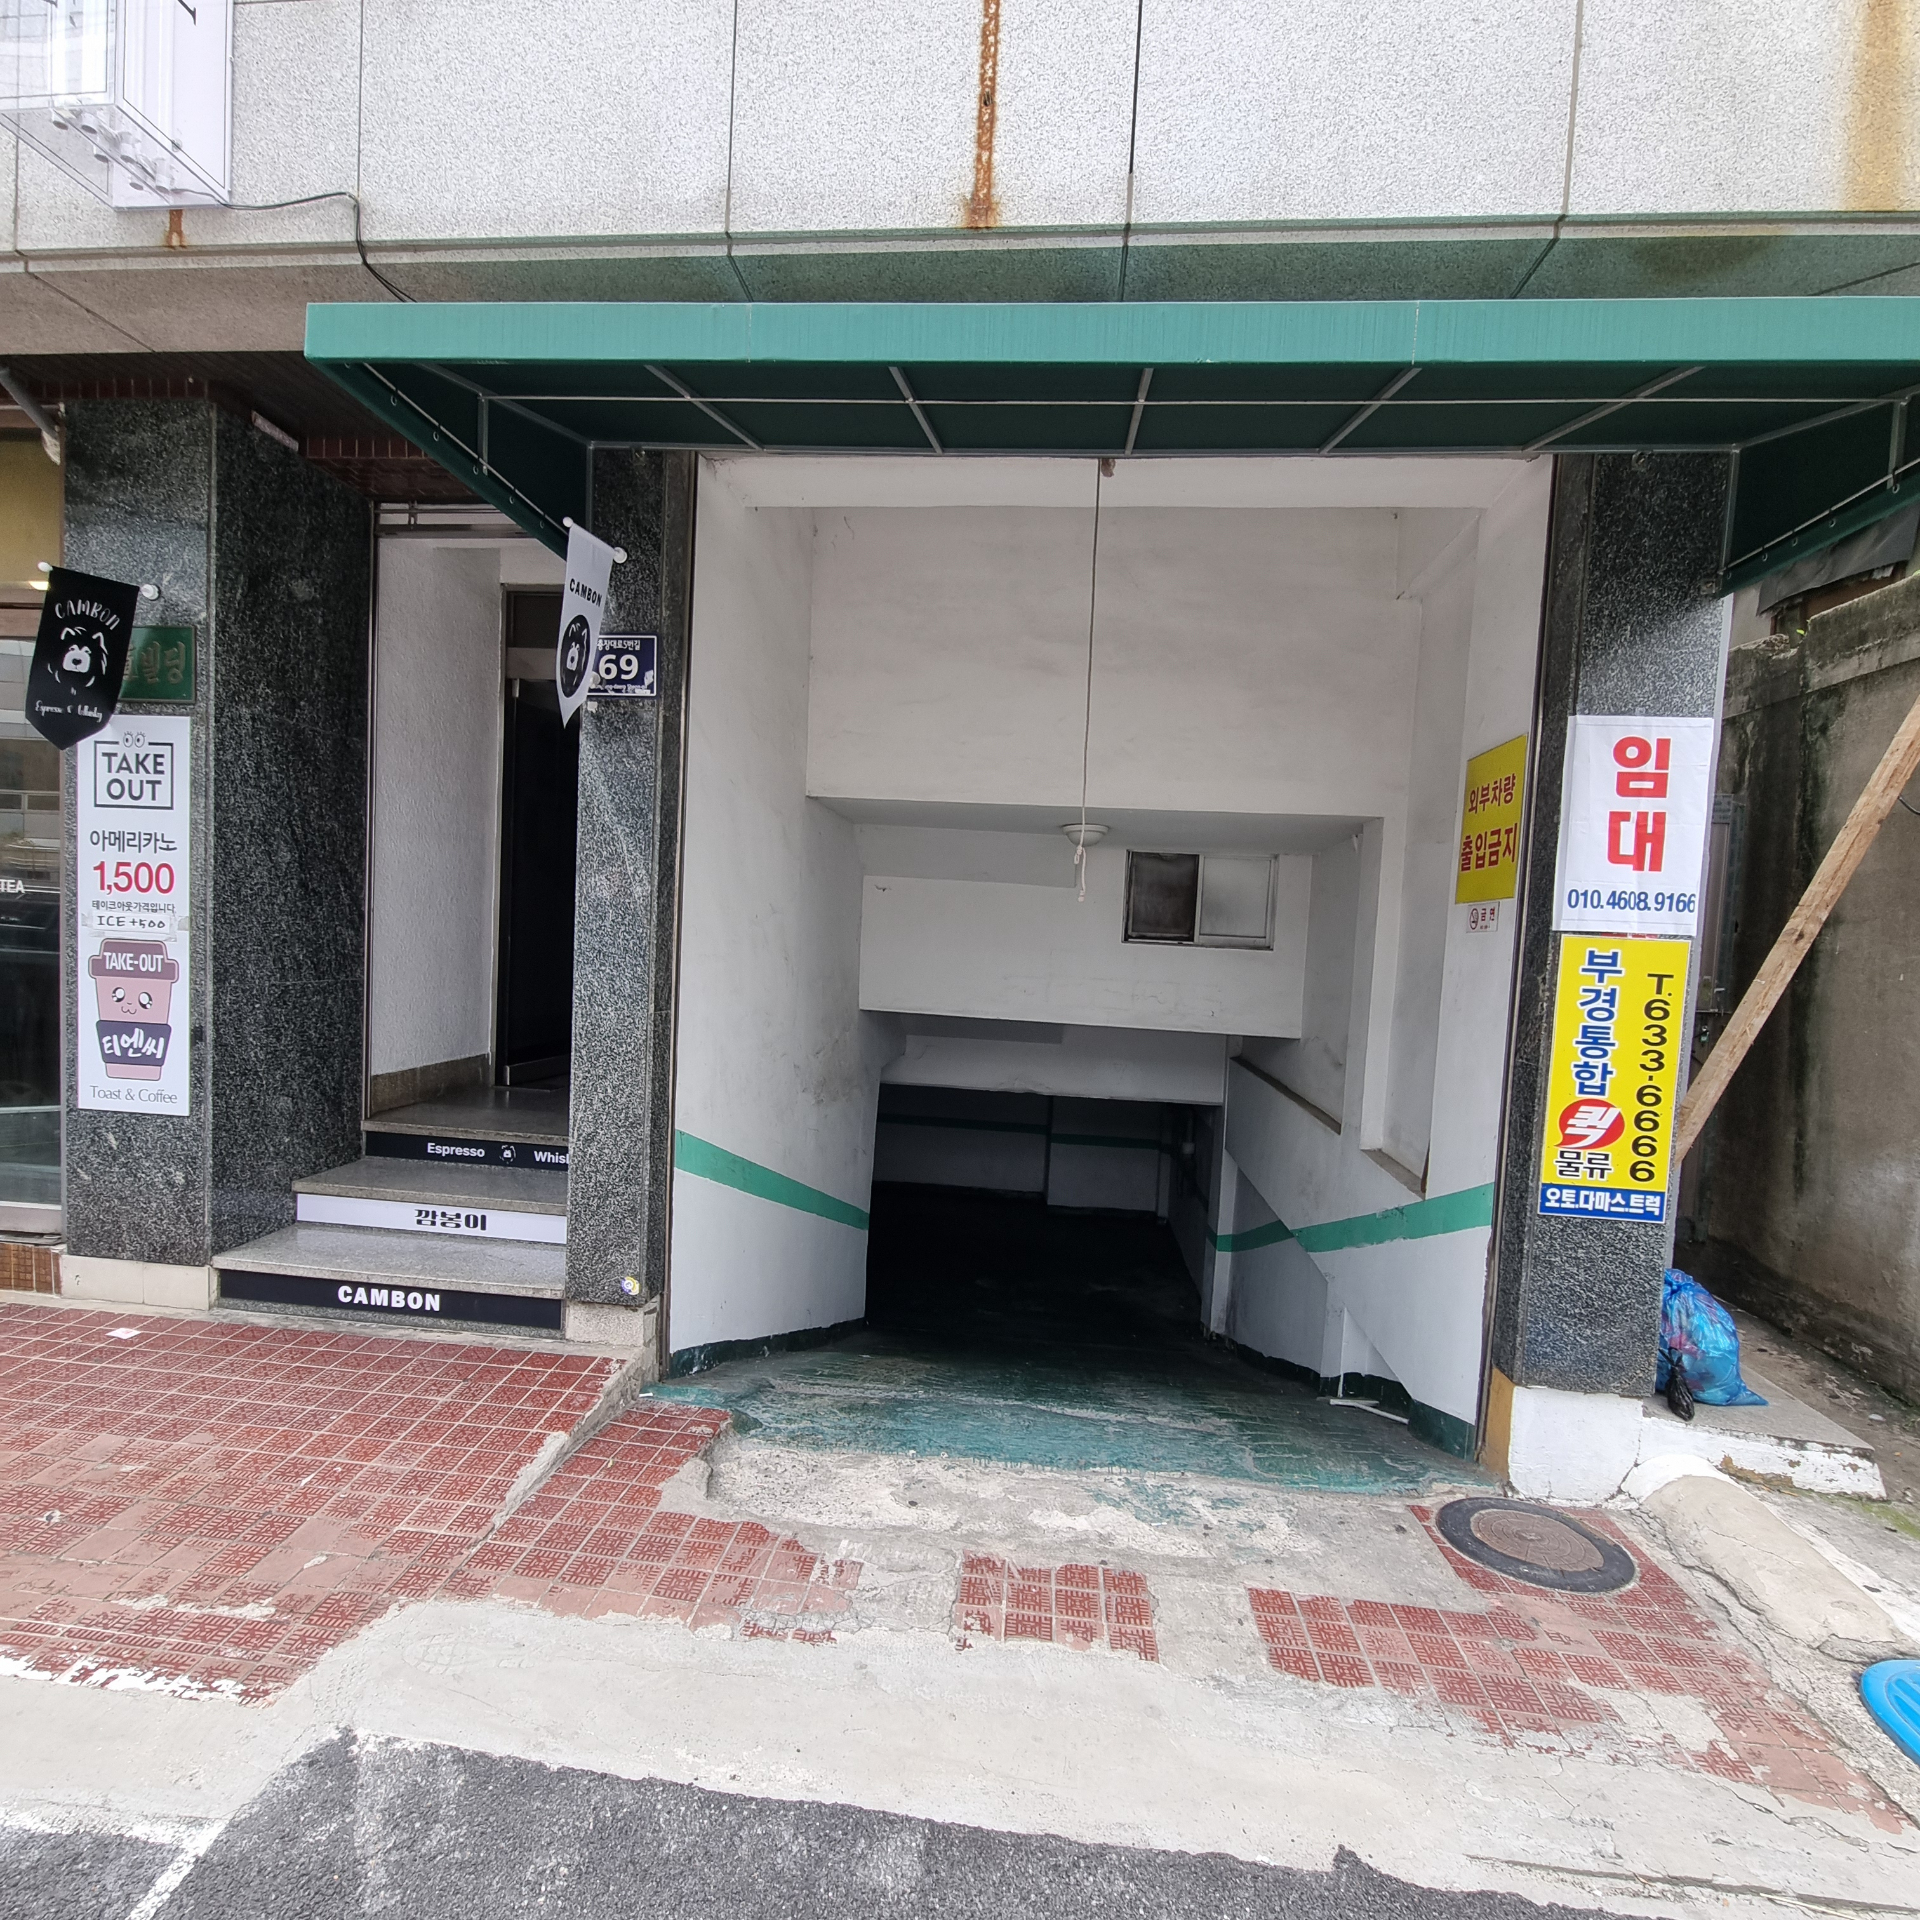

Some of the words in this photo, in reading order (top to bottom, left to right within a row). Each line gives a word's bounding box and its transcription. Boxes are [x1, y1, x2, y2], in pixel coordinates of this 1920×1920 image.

[569, 578, 602, 608] CAMBON
[55, 599, 121, 631] CAMBON
[598, 654, 639, 680] 69
[101, 752, 165, 775] TAKE
[106, 777, 162, 801] OUT
[1468, 773, 1517, 814] 외부차량
[1607, 735, 1672, 873] 임대
[90, 829, 178, 854] 아메리카노
[1460, 822, 1518, 872] 출입금지
[92, 861, 175, 895] 1,500
[1567, 888, 1696, 914] 010.4608.9166
[96, 915, 126, 927] ICE
[129, 918, 166, 929] +500
[104, 952, 164, 973] TAKE-OUT
[1572, 949, 1624, 1097] 부경통합
[101, 1028, 165, 1059] 티엔씨
[1629, 973, 1674, 1183] T.633-6666
[89, 1085, 122, 1101] Toast
[124, 1088, 136, 1101] &
[138, 1088, 178, 1104] Coffee
[1555, 1104, 1622, 1148] 퀵
[427, 1142, 485, 1158] Espresso
[1555, 1150, 1612, 1181] 물류
[415, 1208, 487, 1232] 깜봉이
[338, 1285, 441, 1312] CAMBON
